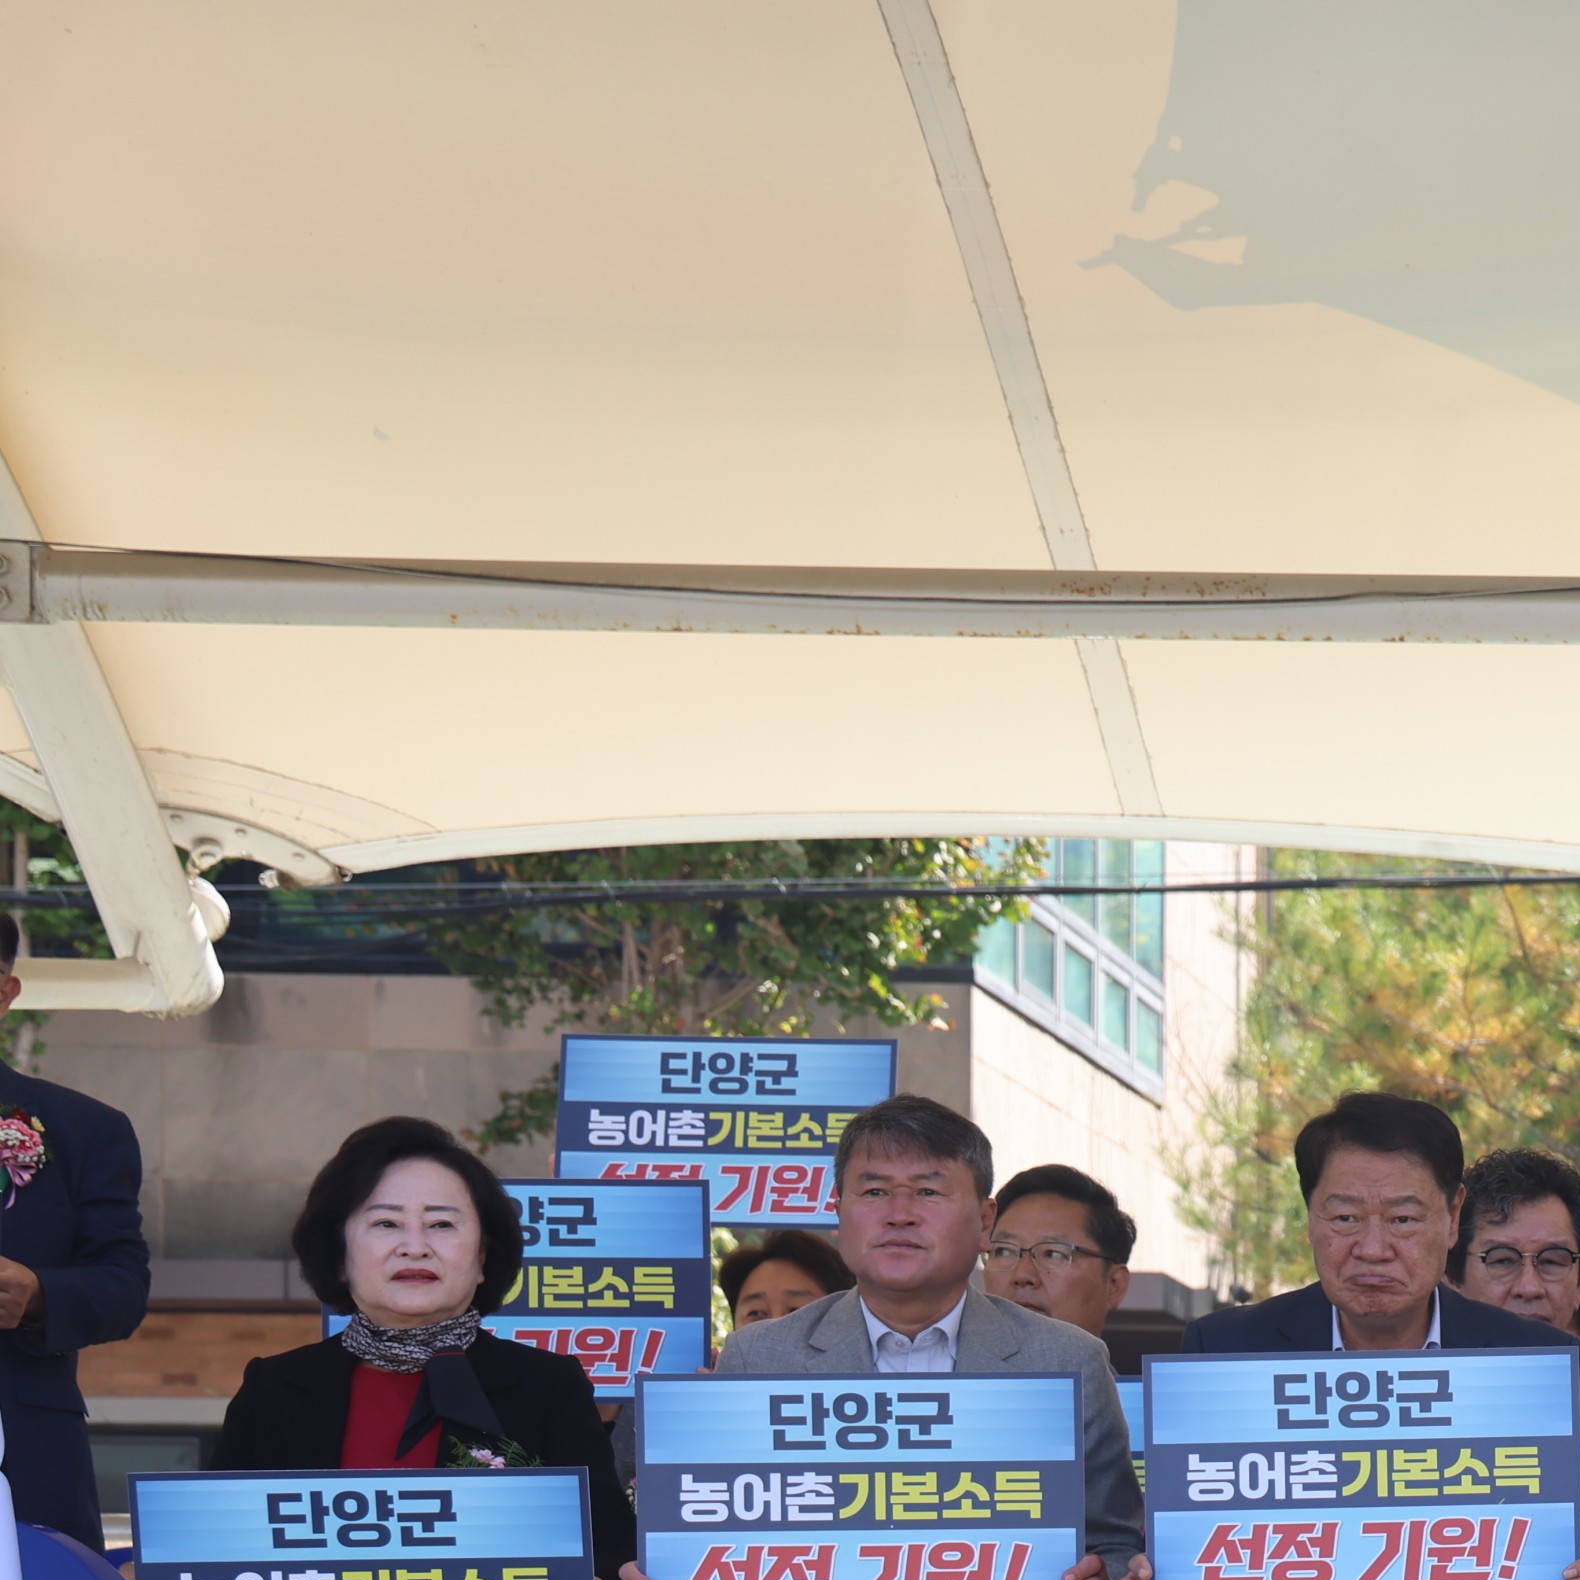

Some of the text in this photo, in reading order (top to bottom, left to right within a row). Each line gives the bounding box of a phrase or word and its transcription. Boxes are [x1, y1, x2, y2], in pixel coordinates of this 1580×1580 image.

[659, 1051, 799, 1096] 단양군
[514, 1196, 597, 1247] 양군
[502, 1265, 675, 1309] 기본소득
[769, 1392, 954, 1451] 단양군
[1273, 1370, 1453, 1430] 단양군
[266, 1489, 457, 1549] 단양군
